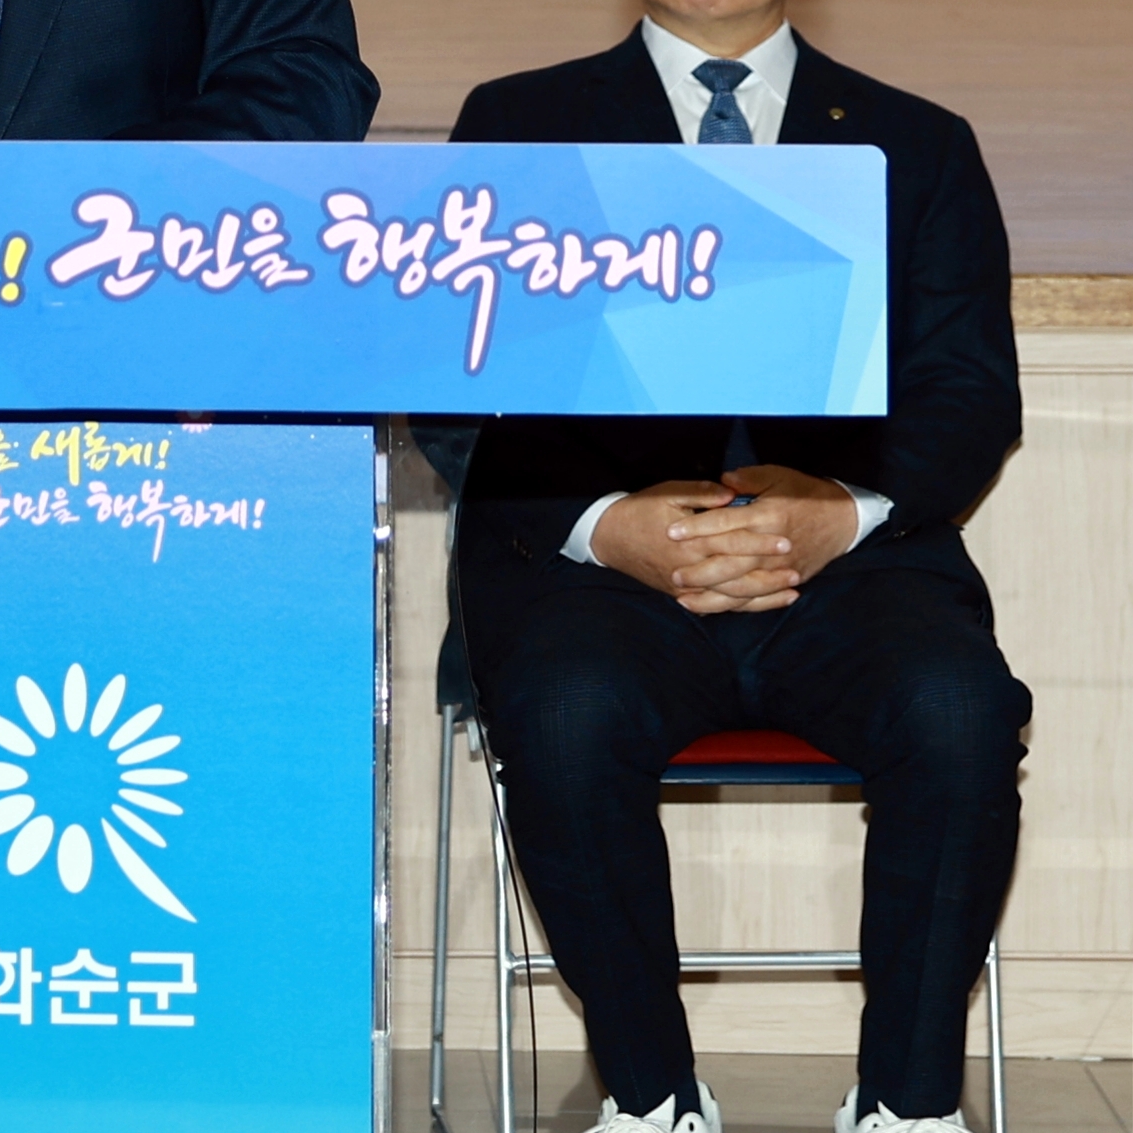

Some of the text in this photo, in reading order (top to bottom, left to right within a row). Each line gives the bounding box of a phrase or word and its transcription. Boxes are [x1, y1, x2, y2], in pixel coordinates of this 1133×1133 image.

[48, 189, 310, 297] 군민을
[320, 185, 719, 373] 행복하게!
[30, 421, 170, 486] 새롭게!
[86, 479, 265, 564] 행복하게!
